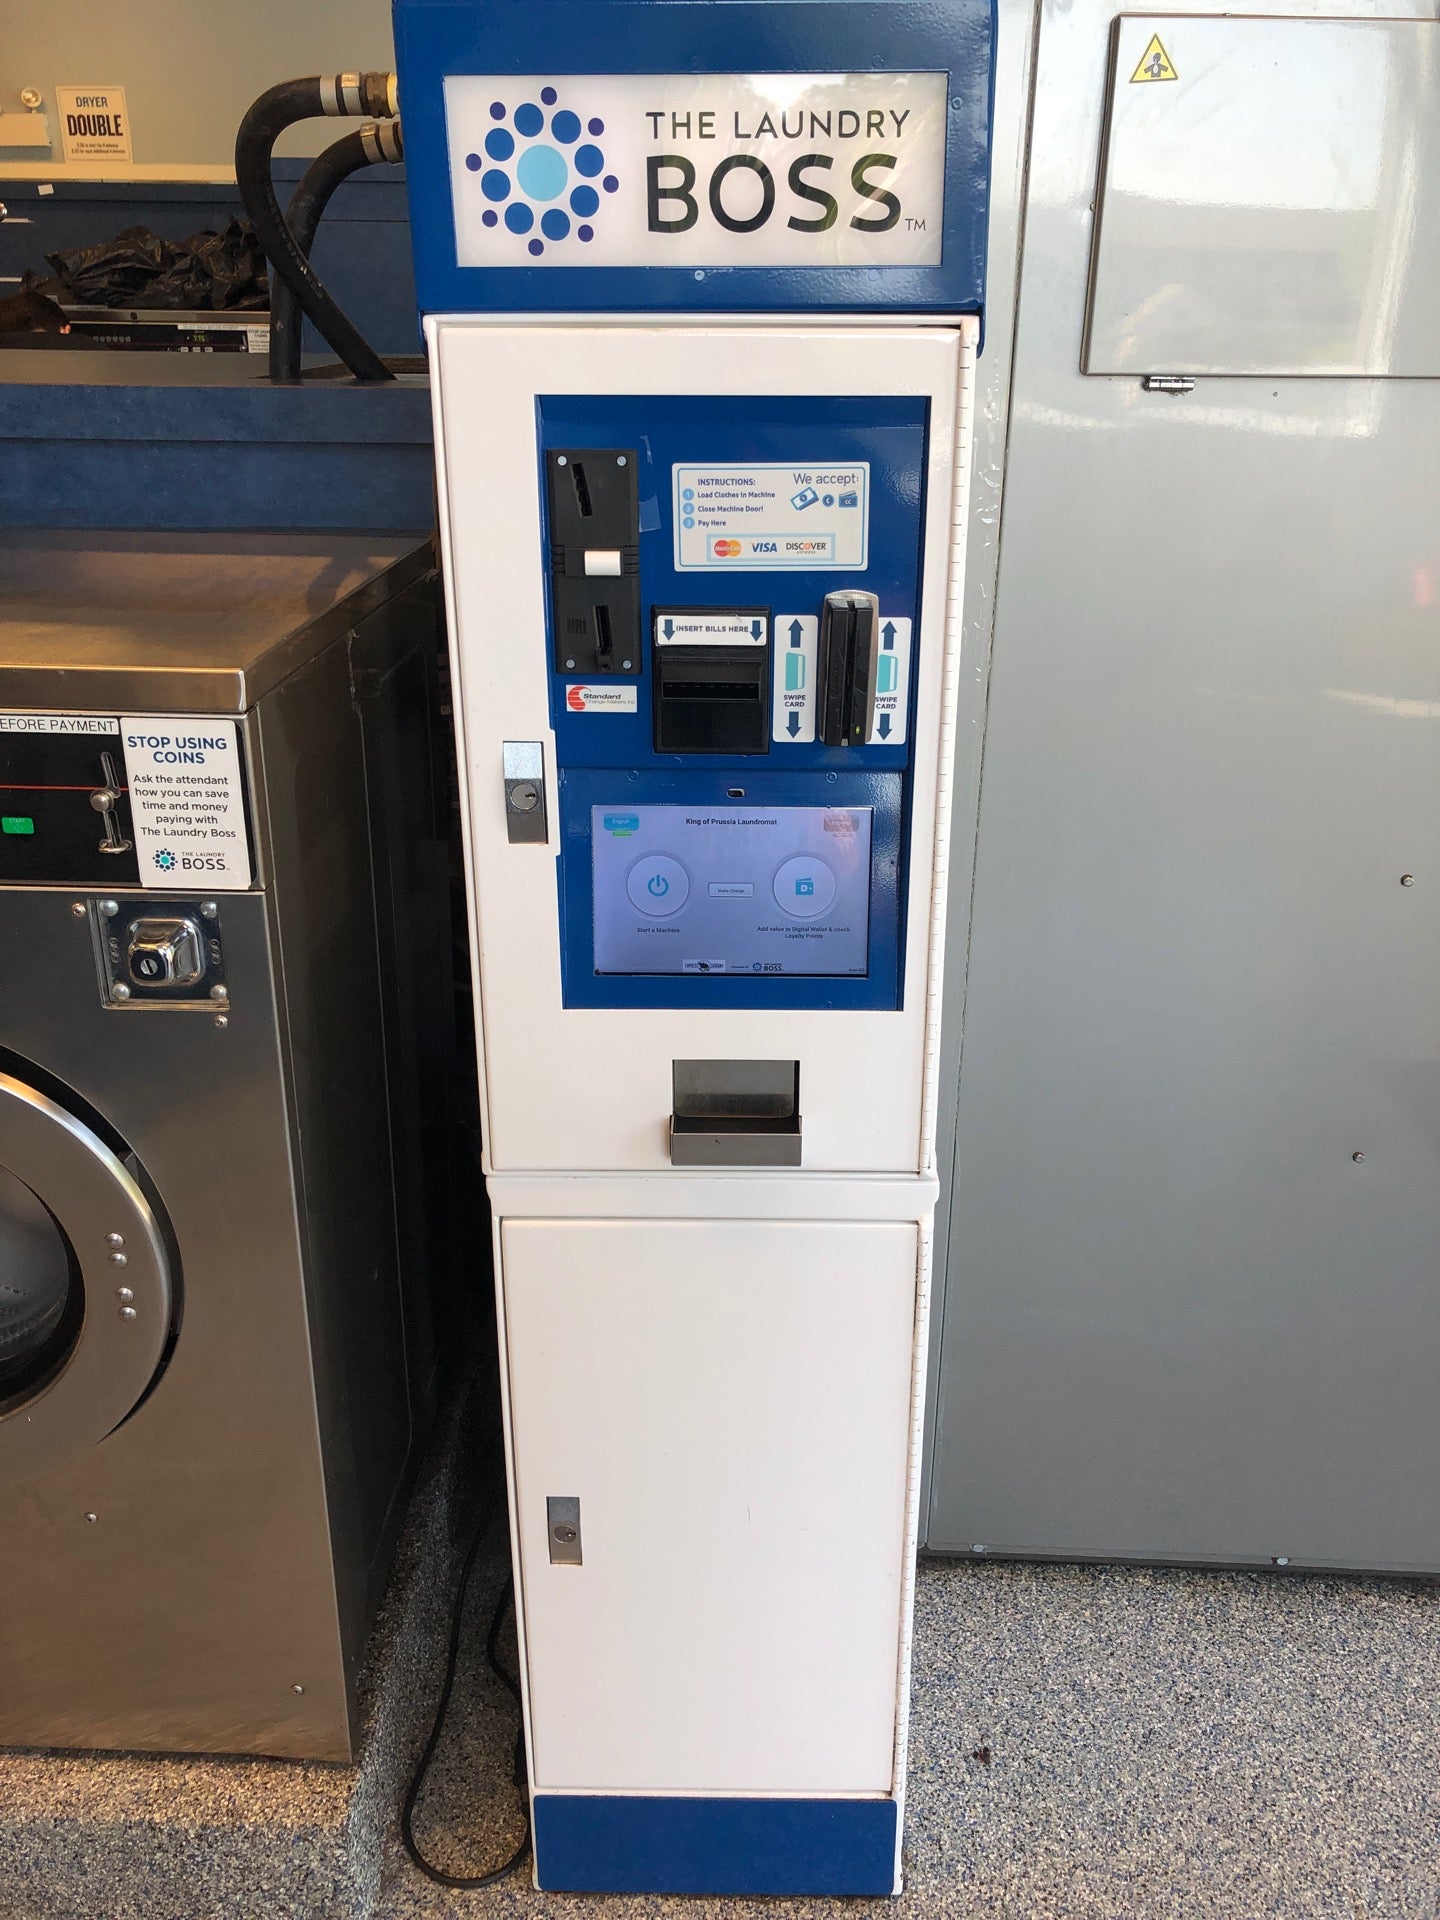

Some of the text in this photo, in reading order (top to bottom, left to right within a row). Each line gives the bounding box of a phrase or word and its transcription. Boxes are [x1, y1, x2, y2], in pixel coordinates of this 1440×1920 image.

[76, 96, 108, 108] DRYER
[66, 114, 124, 136] DOUBLE
[645, 110, 910, 139] THE LAUNDRY
[646, 153, 926, 233] BOSS TM
[697, 478, 756, 486] INSTRUCTIONS:
[793, 473, 859, 487] We accept:
[698, 520, 710, 528] Pay
[751, 542, 778, 553] VISA
[785, 542, 827, 550] DISCOVER
[728, 625, 749, 633] HERE
[0, 718, 115, 732] EFORE PAYMENT
[127, 736, 227, 750] STOP USING
[153, 751, 206, 764] COINS
[133, 774, 229, 785] Ask the attendant
[135, 787, 158, 796] how
[160, 789, 180, 798] you
[183, 790, 202, 798] can
[142, 801, 228, 813] time and money
[156, 815, 218, 825] paying with
[685, 818, 701, 826] King
[140, 827, 236, 838] The Laundry Boss
[181, 858, 226, 870] BOSS
